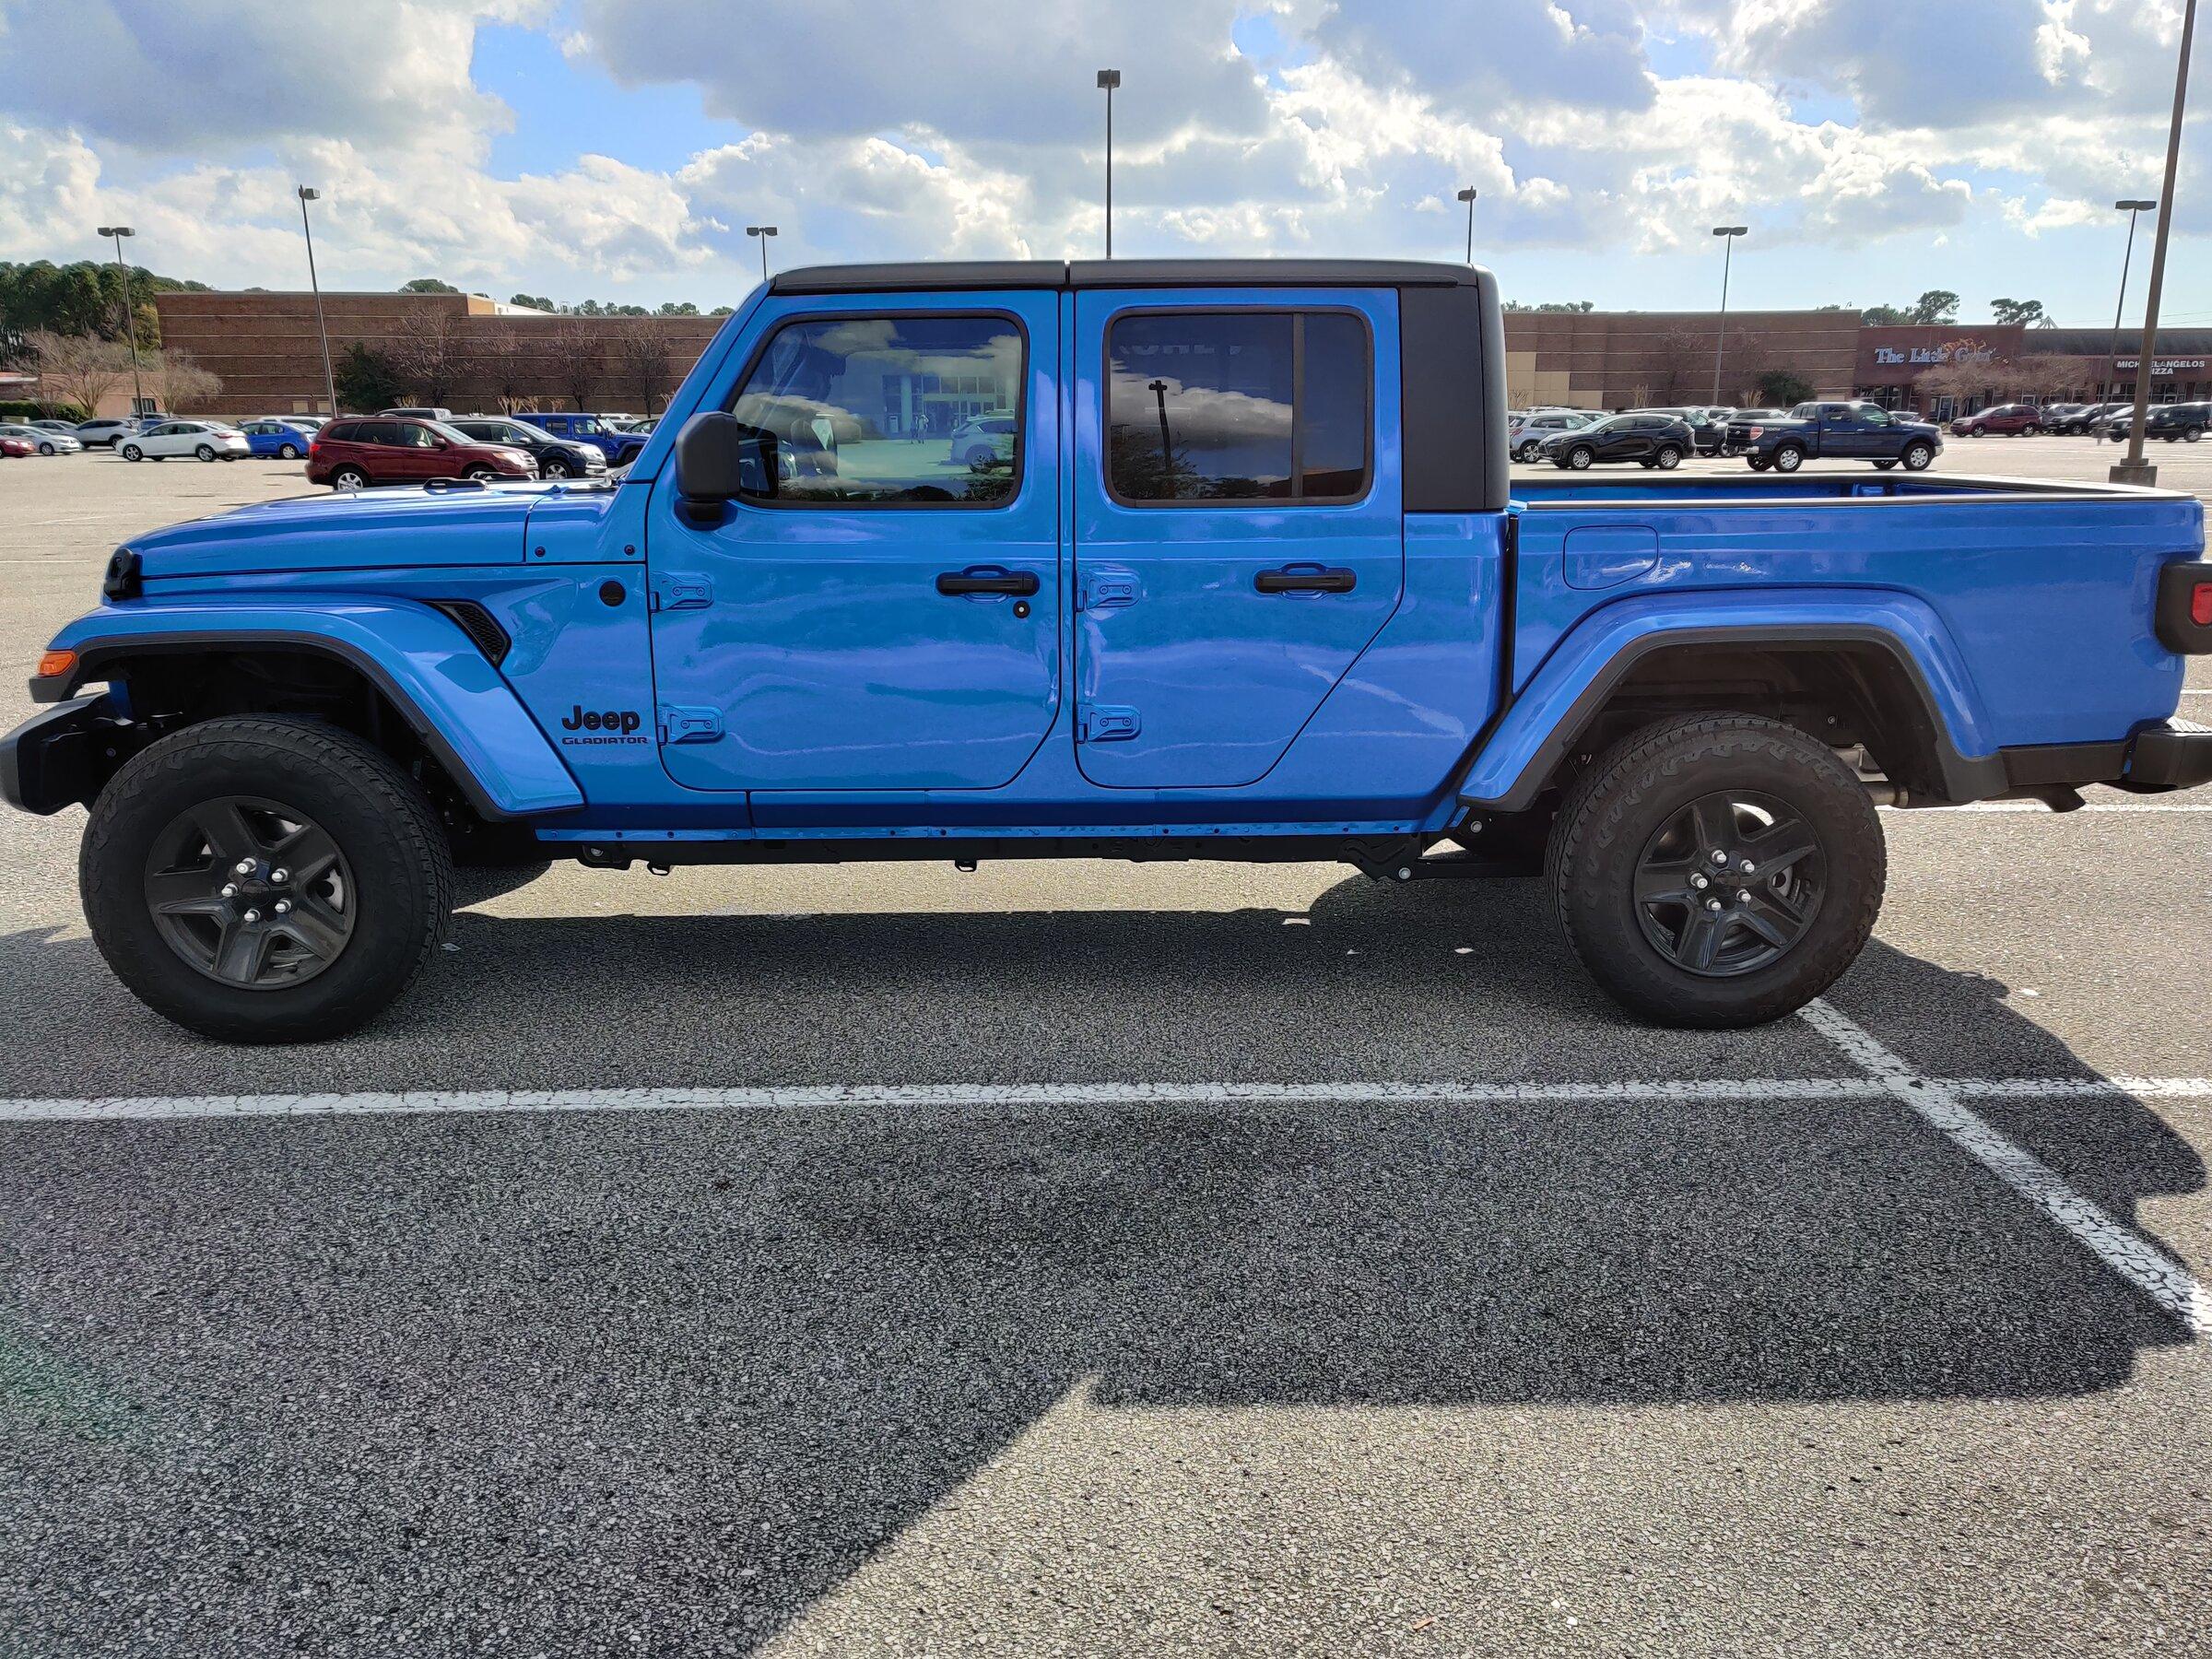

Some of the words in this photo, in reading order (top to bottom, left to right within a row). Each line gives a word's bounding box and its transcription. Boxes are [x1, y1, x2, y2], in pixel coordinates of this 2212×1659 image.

[1875, 347, 1905, 363] The
[561, 705, 641, 735] Jeep
[561, 736, 649, 745] GLADIATOR
